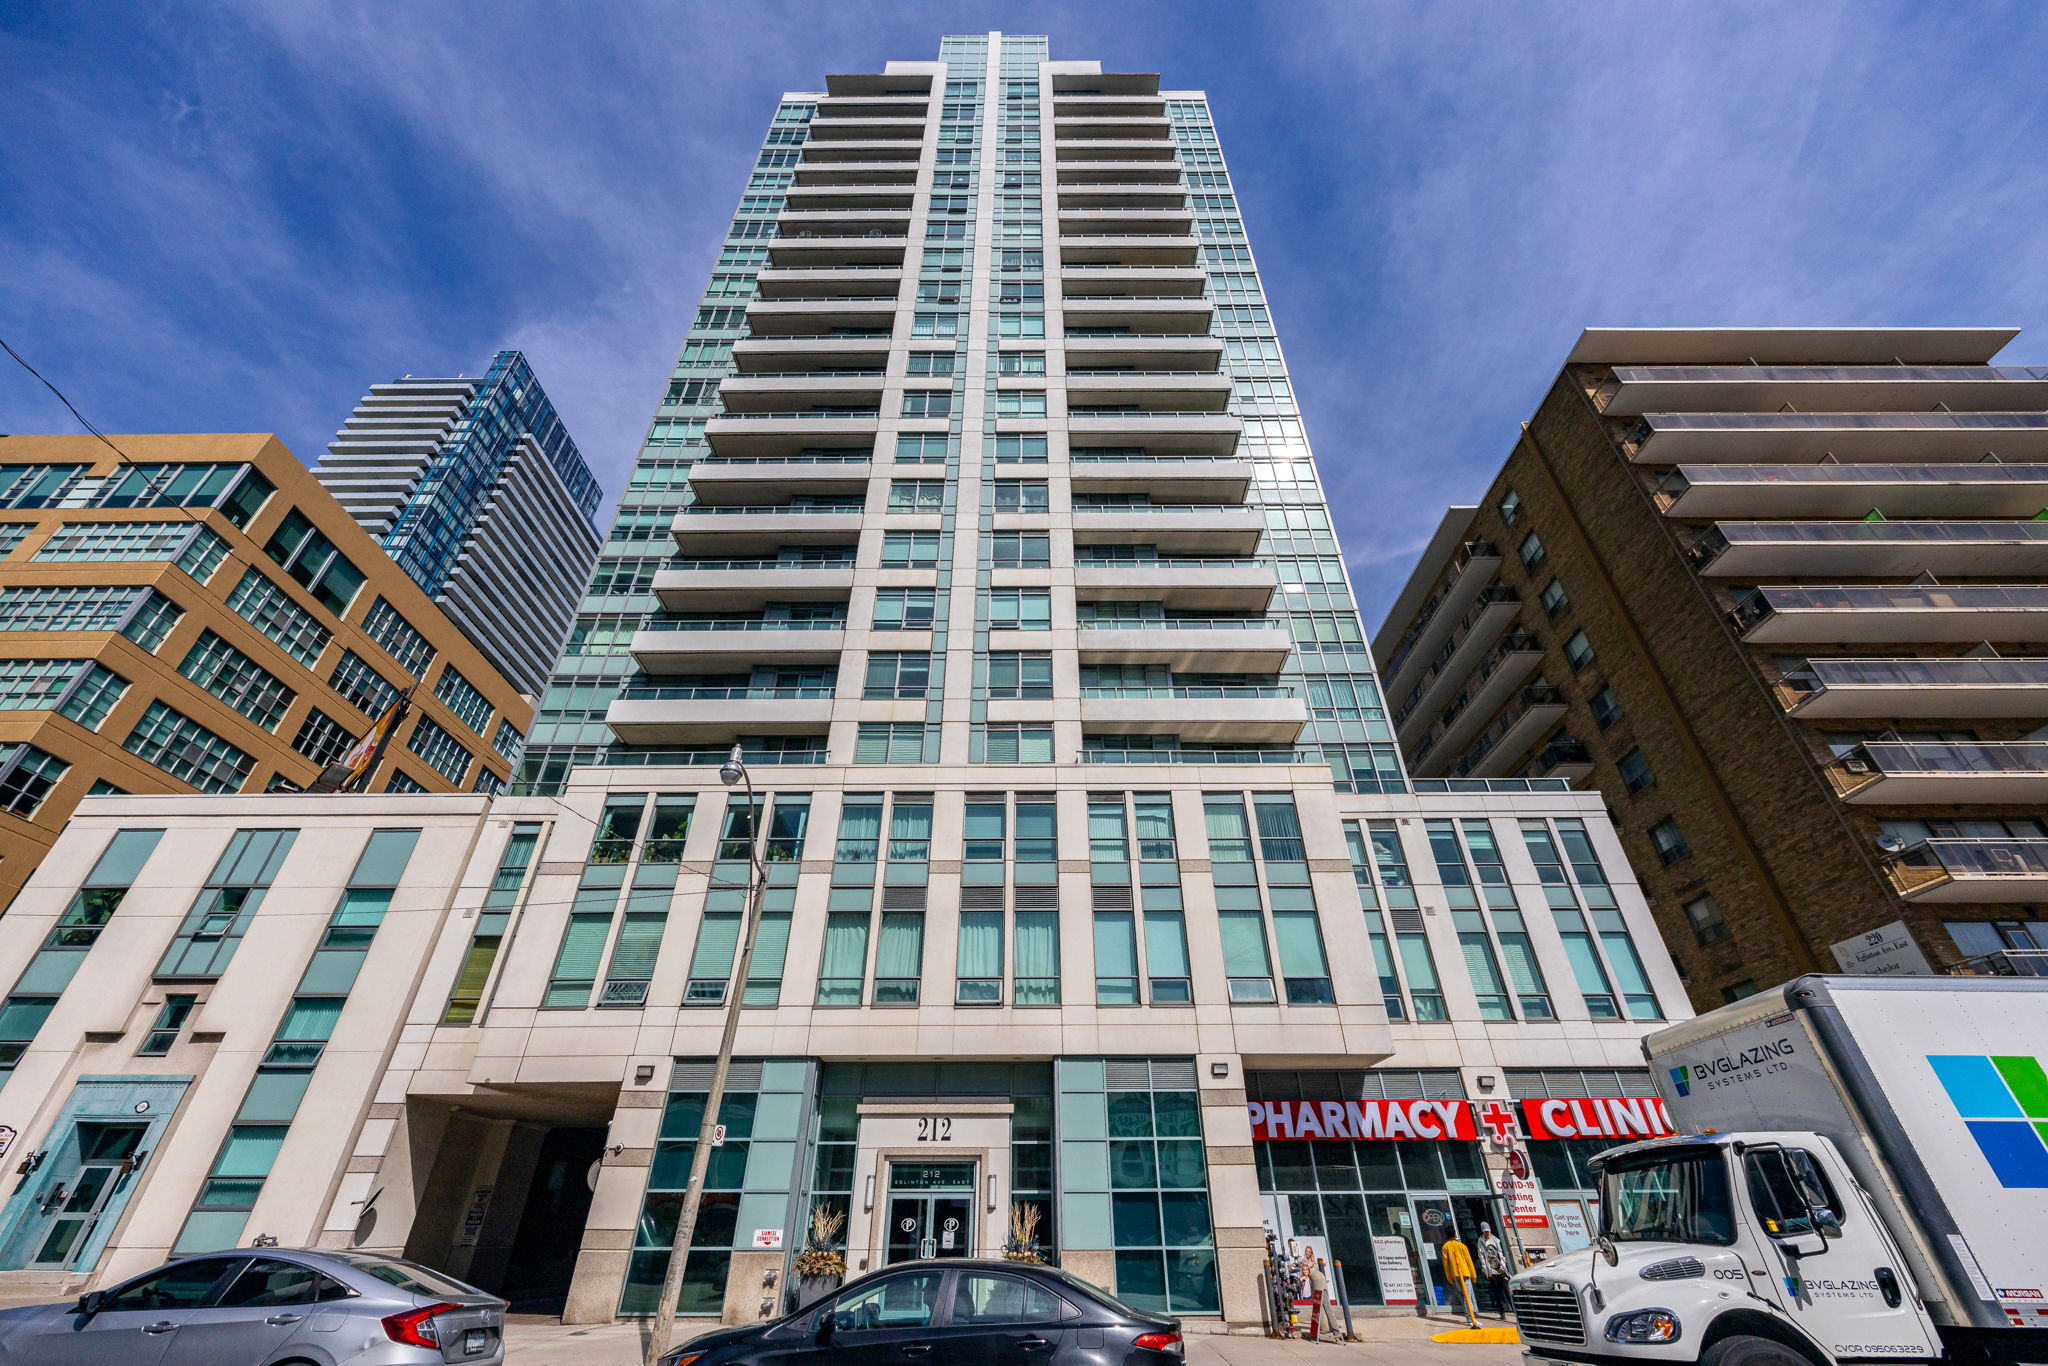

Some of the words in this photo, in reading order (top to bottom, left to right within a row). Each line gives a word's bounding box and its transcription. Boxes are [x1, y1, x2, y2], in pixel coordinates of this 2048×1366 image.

[1865, 931, 1884, 947] 220
[1893, 940, 1909, 950] East
[1693, 1038, 1795, 1080] BVGLAZING
[1708, 1069, 1762, 1090] SYSTEMS
[1248, 1100, 1459, 1138] PHARMACY
[917, 1117, 952, 1142] 212
[922, 1170, 941, 1178] 212
[1496, 1181, 1535, 1190] COVID-19
[1506, 1192, 1534, 1203] esting
[1423, 1212, 1443, 1222] OPEN
[1567, 1221, 1582, 1229] Shot
[1713, 1269, 1744, 1280] 005
[1803, 1280, 1879, 1290] BVGLAZING
[2005, 1289, 2041, 1298] MORGAN
[1834, 1344, 1864, 1353] CVOR
[1864, 1344, 1925, 1353] 095063229
